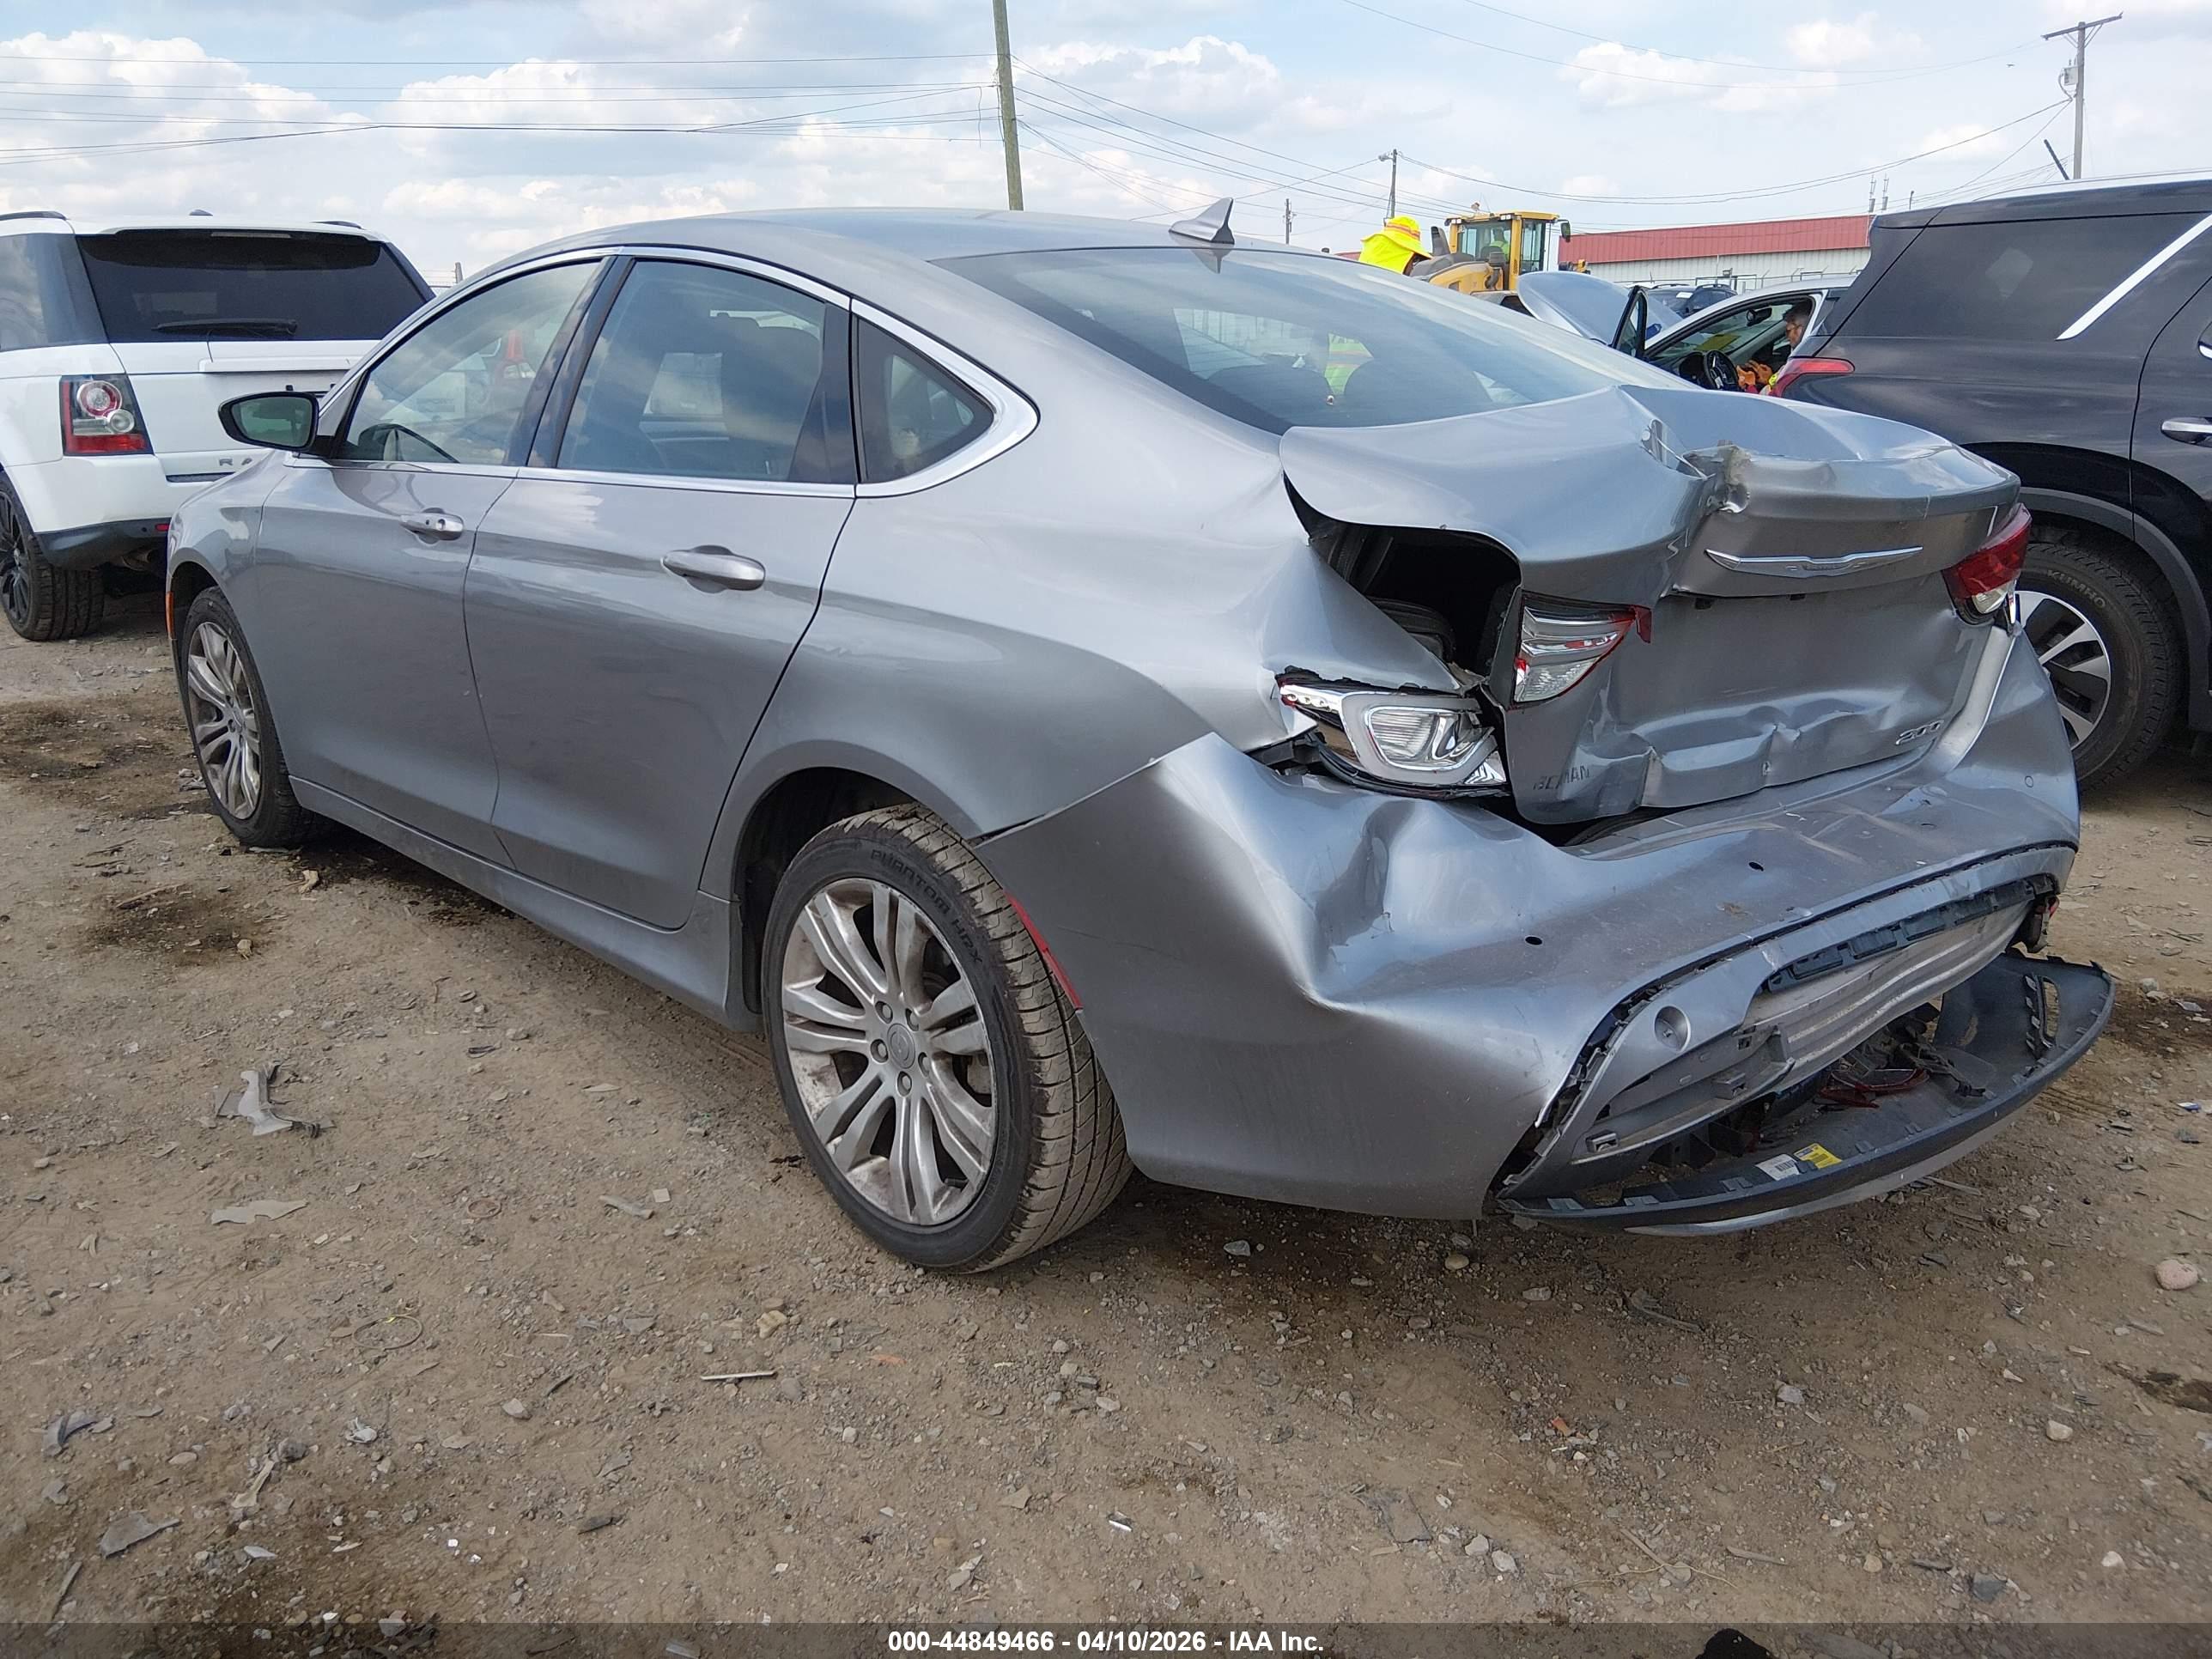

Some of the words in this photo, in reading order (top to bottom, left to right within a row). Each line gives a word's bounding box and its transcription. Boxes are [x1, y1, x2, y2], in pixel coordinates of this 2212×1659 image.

[2047, 570, 2106, 608] KUMHO
[1896, 720, 1944, 745] 200
[871, 849, 950, 915] PHANTOM
